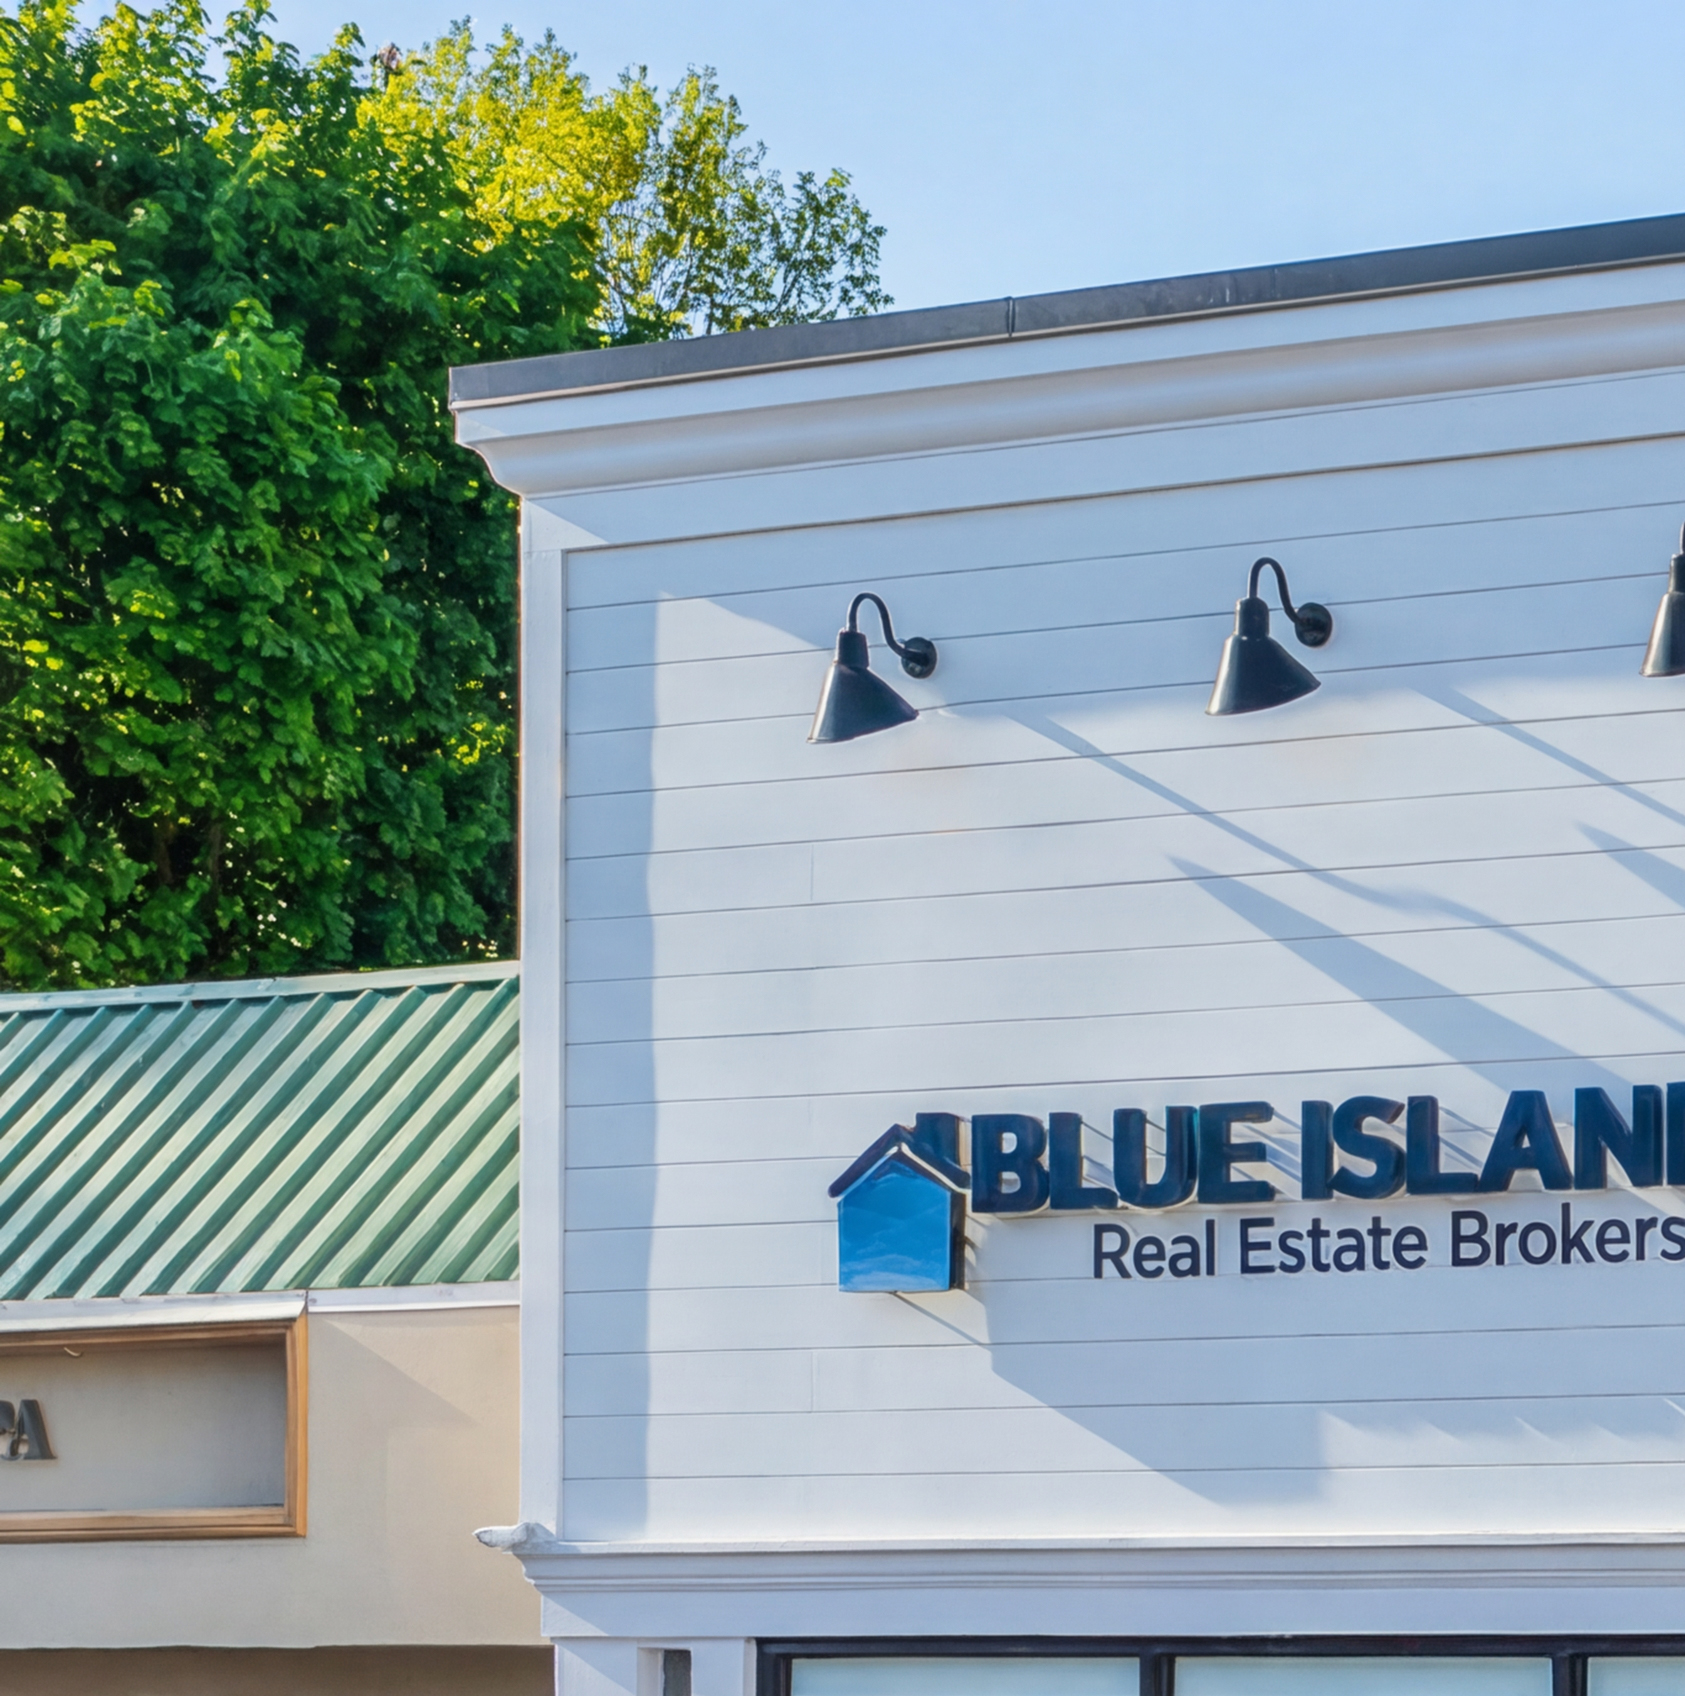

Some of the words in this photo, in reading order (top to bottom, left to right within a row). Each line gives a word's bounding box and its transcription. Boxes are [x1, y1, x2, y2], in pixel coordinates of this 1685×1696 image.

[970, 1101, 1274, 1213] BLUE
[1093, 1218, 1216, 1280] Real
[1239, 1215, 1429, 1276] Estate
